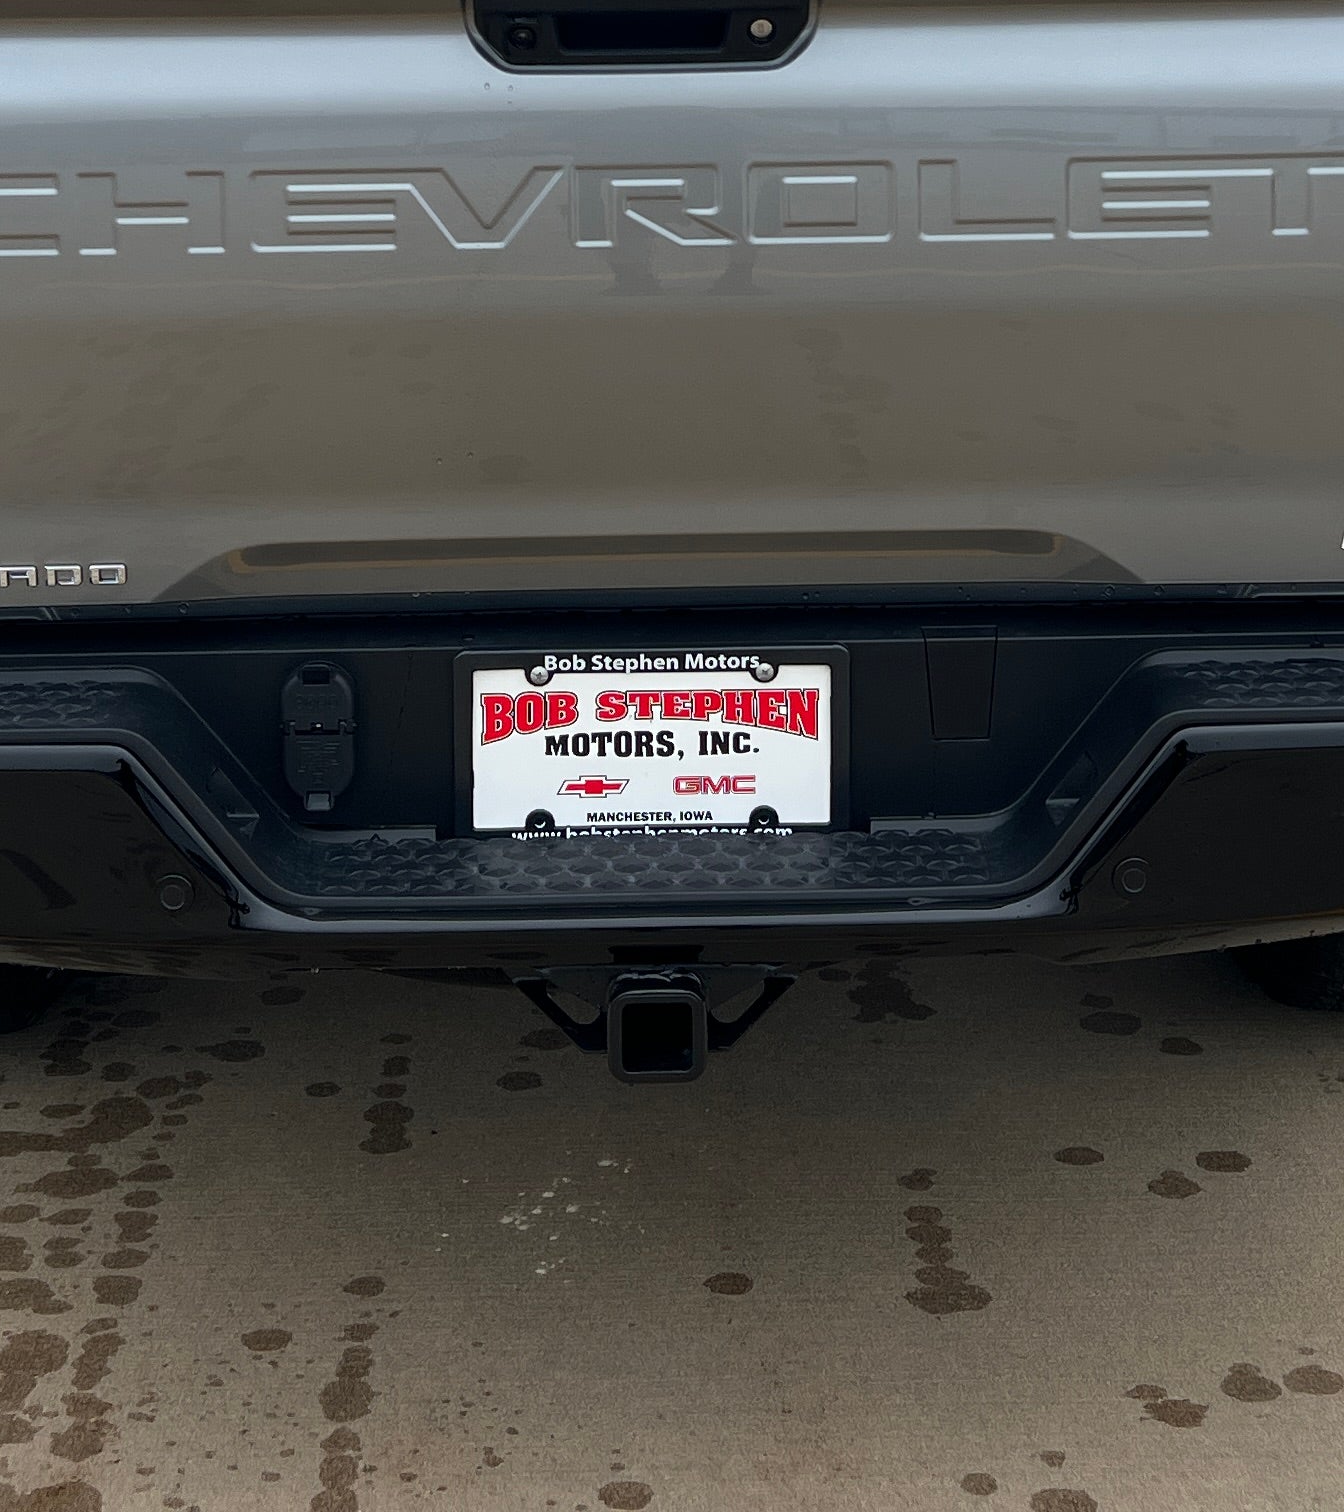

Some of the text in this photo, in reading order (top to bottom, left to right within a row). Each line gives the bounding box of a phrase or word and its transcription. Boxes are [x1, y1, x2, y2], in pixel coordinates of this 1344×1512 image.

[544, 653, 760, 674] Bob Stephen Motors
[480, 688, 819, 746] BOB STEPHEN
[545, 730, 760, 760] MOTORS, INC.
[673, 775, 756, 795] GMC
[587, 810, 713, 823] MANCHESTER, IOWA
